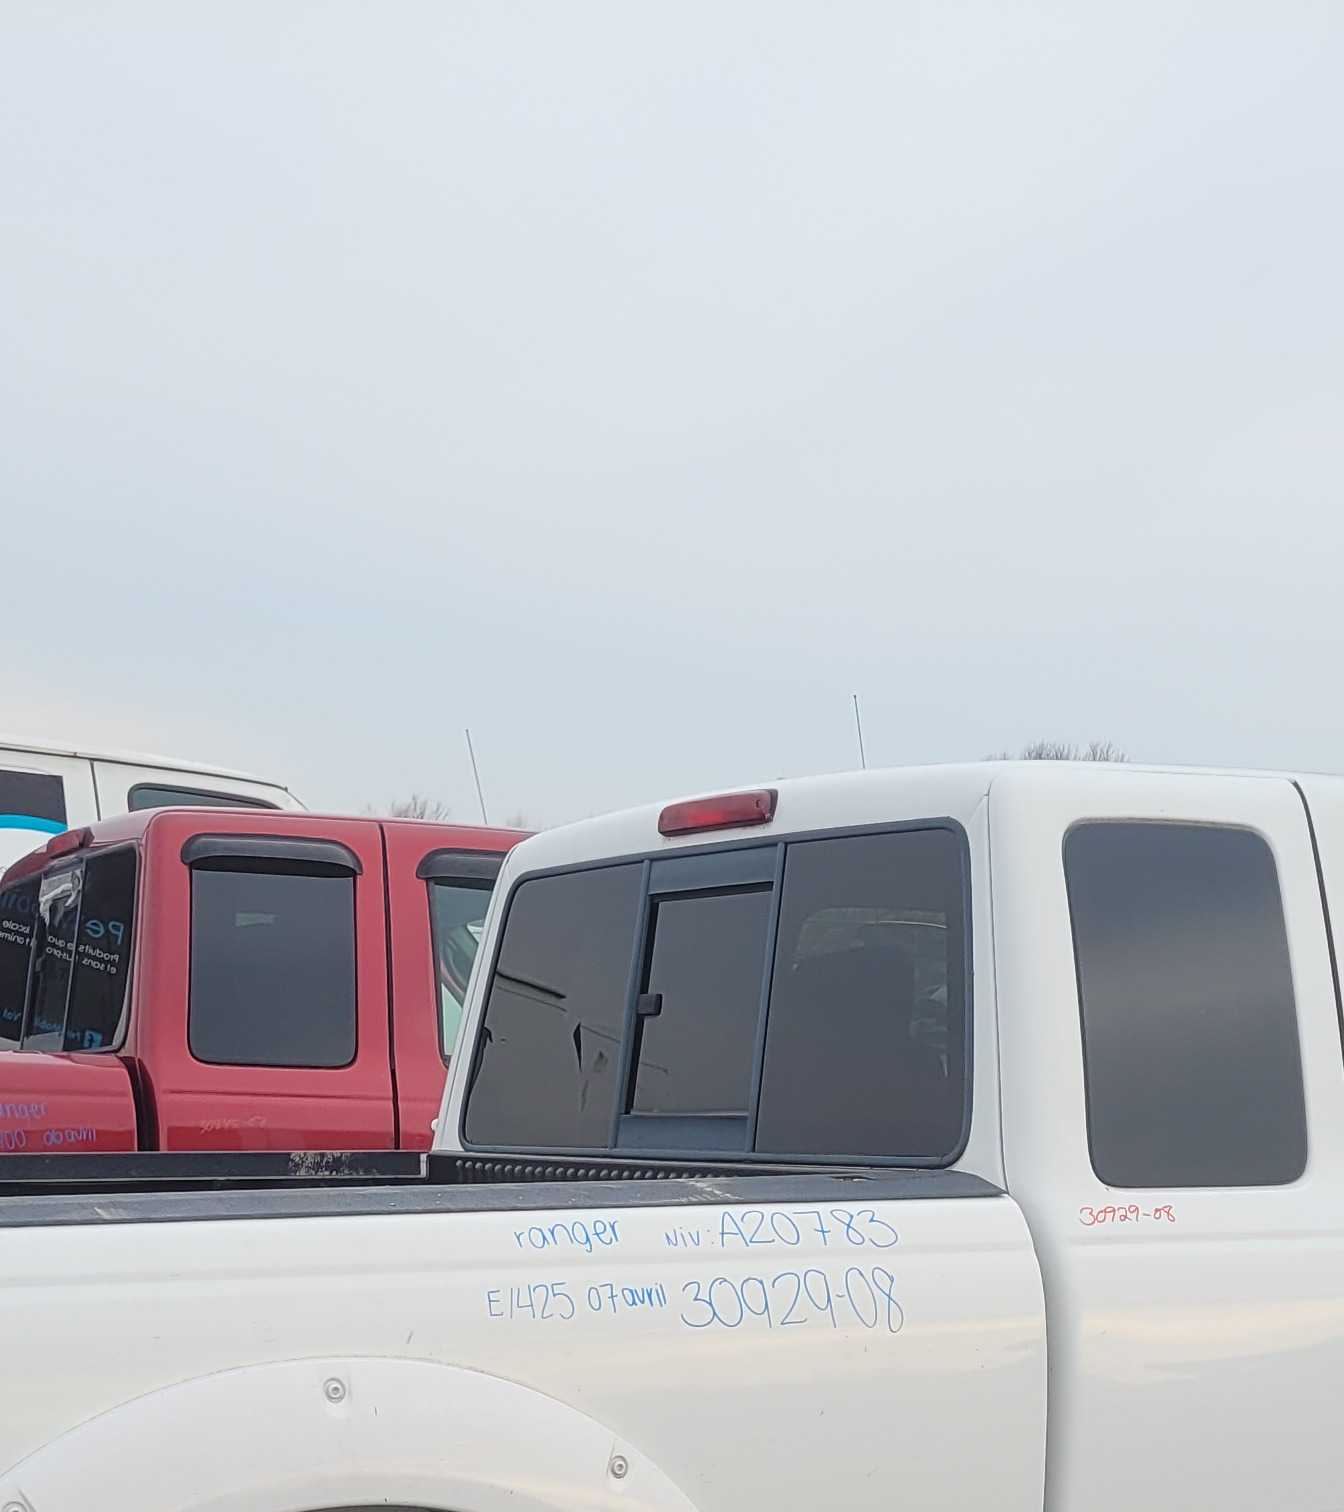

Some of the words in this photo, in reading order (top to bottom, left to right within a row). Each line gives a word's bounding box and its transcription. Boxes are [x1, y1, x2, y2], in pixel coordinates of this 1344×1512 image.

[513, 1219, 620, 1253] ranger
[720, 1208, 899, 1248] A20783
[1079, 1204, 1176, 1226] 30929-08
[587, 1282, 619, 1314] 07
[620, 1282, 667, 1308] avril
[681, 1266, 905, 1334] 30929-08
